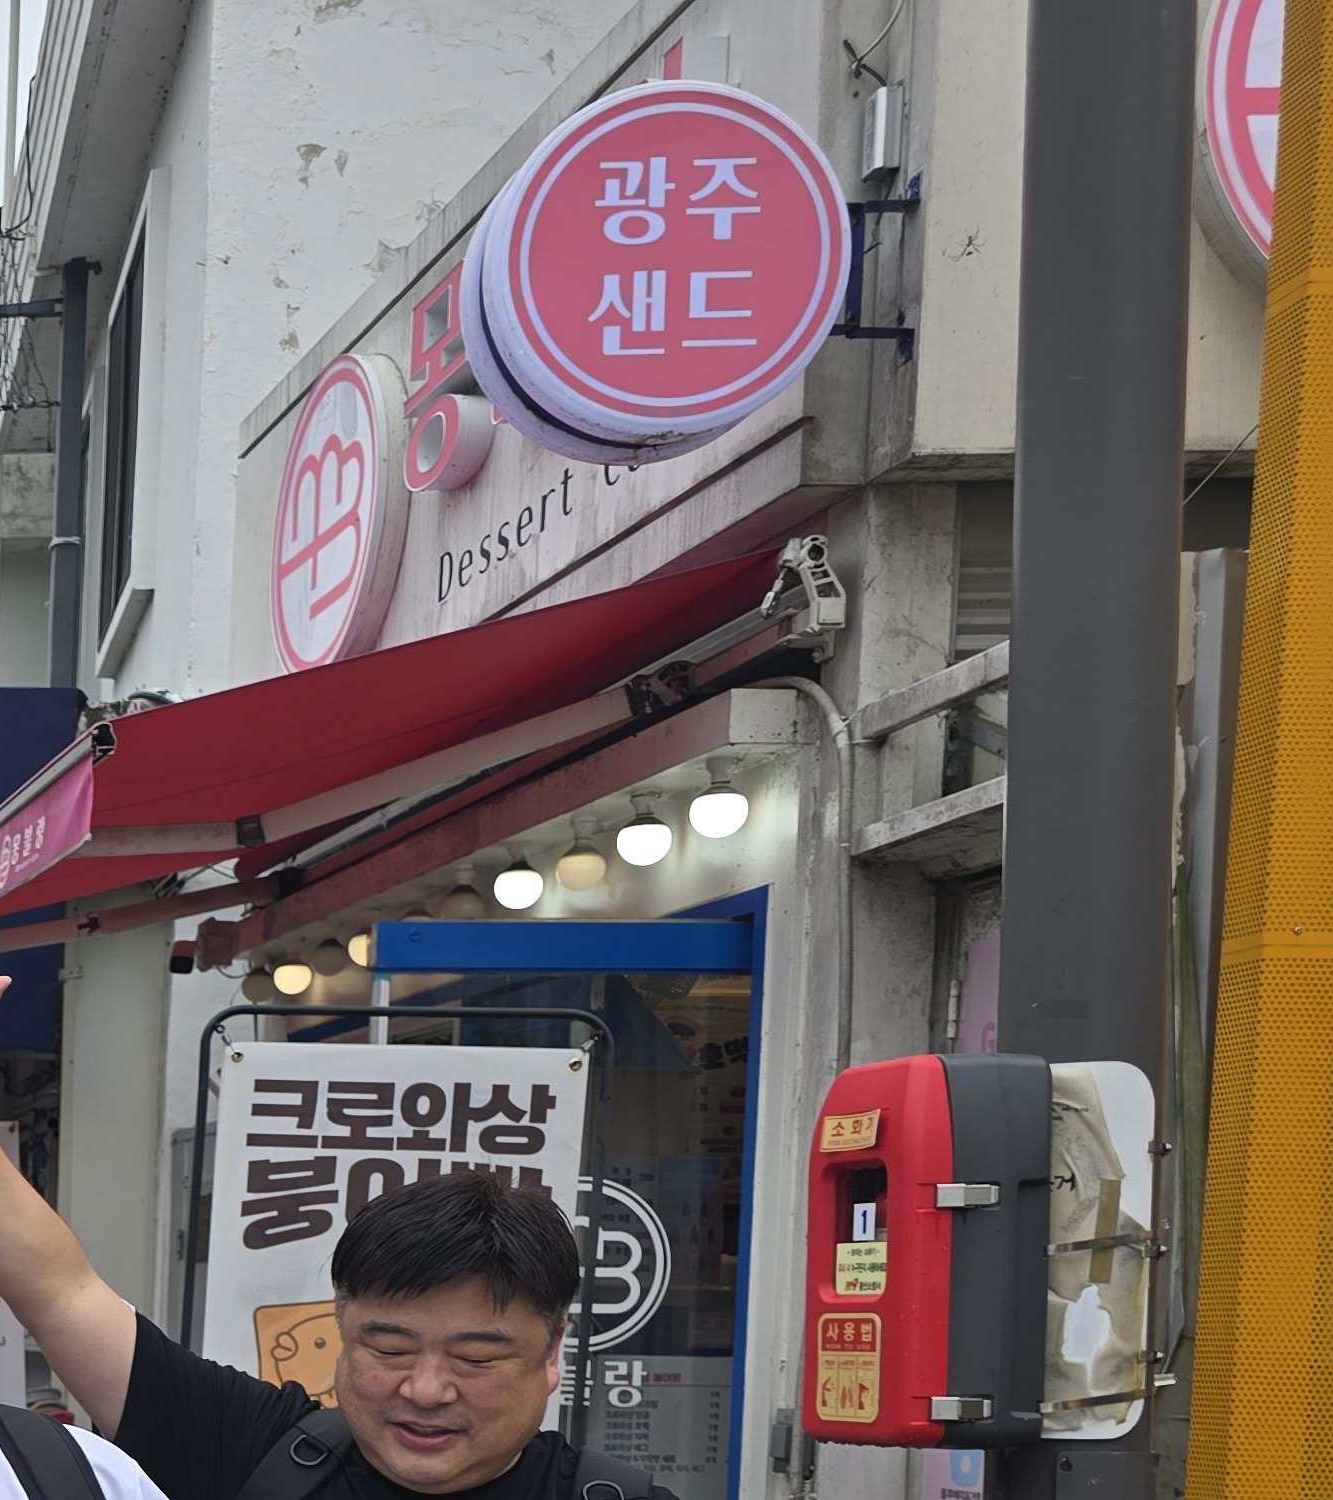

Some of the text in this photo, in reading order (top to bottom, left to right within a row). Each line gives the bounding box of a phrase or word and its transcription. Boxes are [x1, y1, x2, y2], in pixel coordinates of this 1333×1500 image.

[593, 154, 763, 245] 광주
[587, 269, 758, 357] 샌드
[437, 467, 574, 603] Dessert
[245, 1079, 557, 1155] 크로와상
[861, 1209, 868, 1235] 1
[826, 1321, 873, 1342] 사용법
